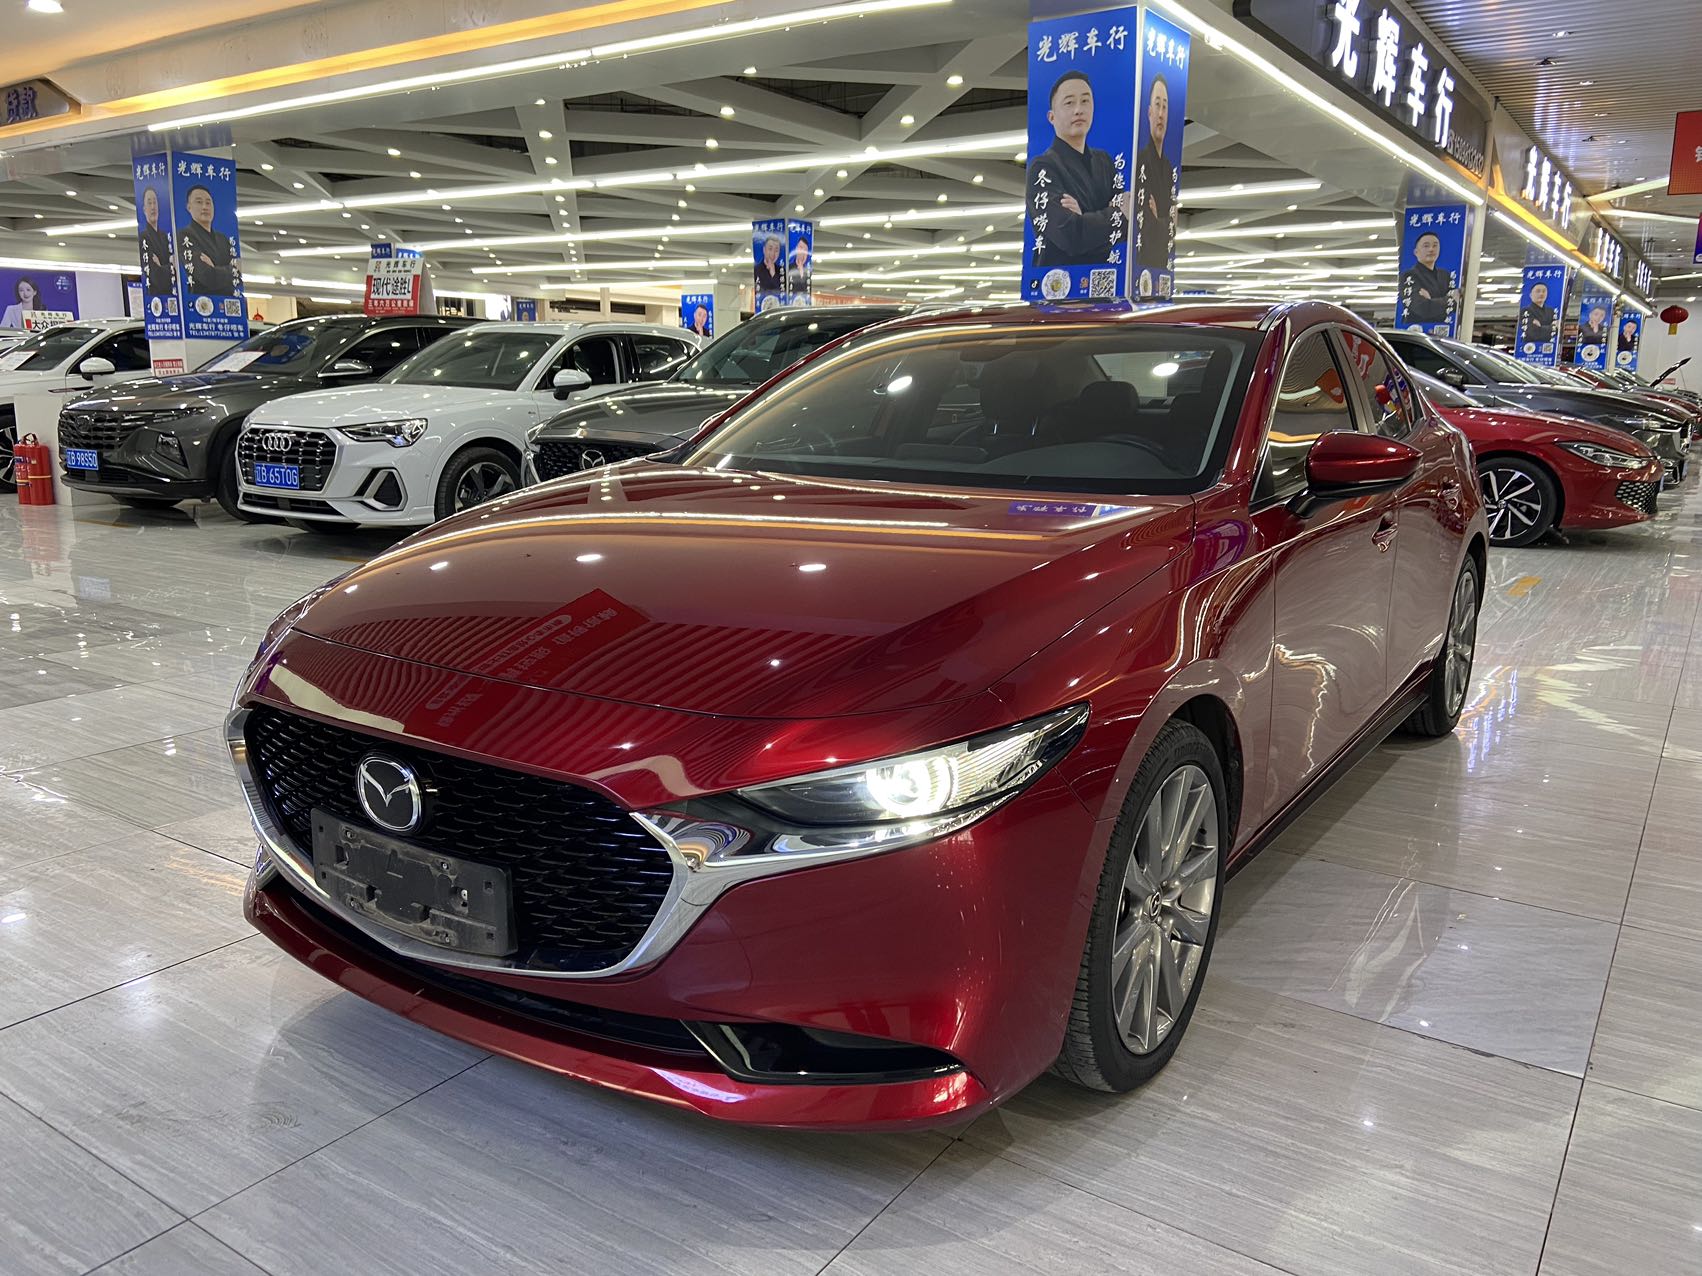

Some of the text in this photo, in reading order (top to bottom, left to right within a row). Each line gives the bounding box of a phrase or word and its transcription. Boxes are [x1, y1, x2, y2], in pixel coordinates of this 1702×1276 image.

[1036, 25, 1128, 63] 光辉车行
[1146, 27, 1186, 70] 光辉车行
[1332, 0, 1456, 148] 光辉车行
[136, 162, 166, 181] 光辉车行
[177, 160, 231, 182] 光辉车行
[1106, 152, 1125, 265] 为您保驾护航
[1409, 212, 1461, 228] 光辉车行
[1526, 269, 1562, 280] 光辉车行
